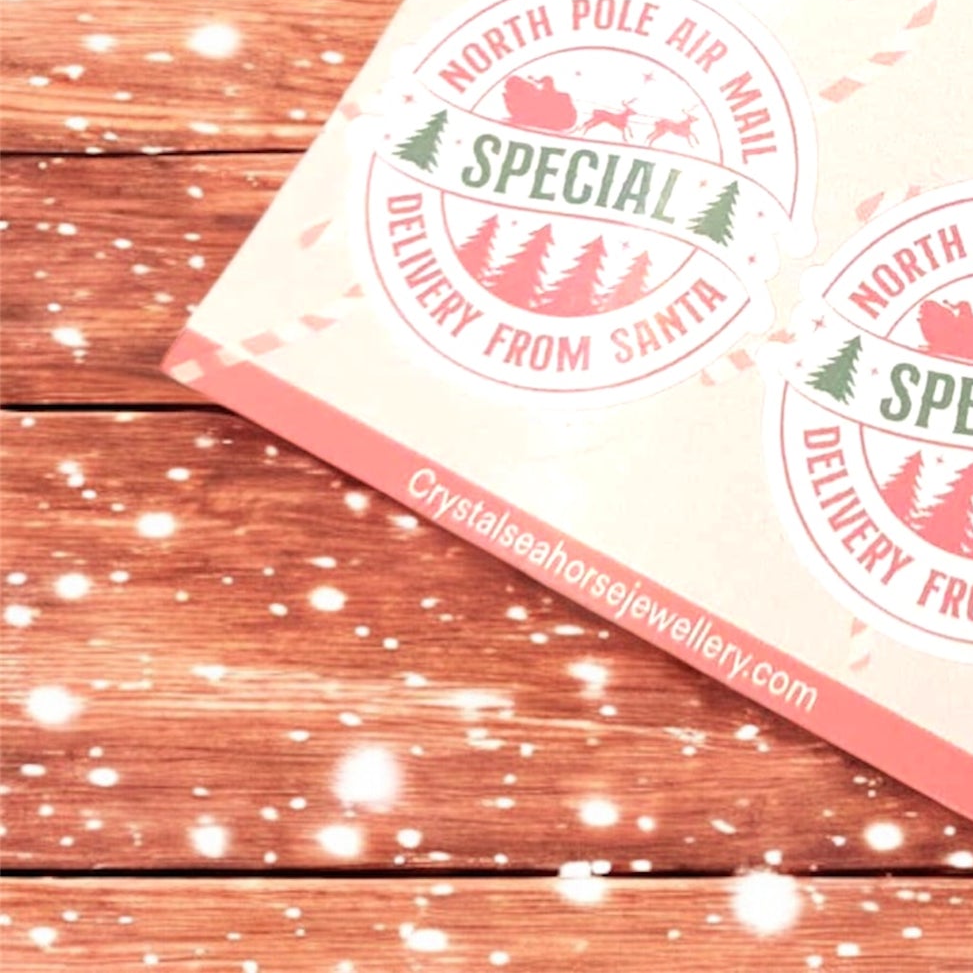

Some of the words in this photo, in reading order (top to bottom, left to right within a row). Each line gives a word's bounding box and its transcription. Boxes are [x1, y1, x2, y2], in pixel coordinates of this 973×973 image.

[438, 5, 553, 94] NORTH
[665, 18, 728, 73] AIR
[719, 71, 778, 165] MAIL
[461, 134, 682, 224] SPECIAL
[386, 193, 484, 337] DELIVERY
[483, 323, 591, 372] FROM
[610, 277, 727, 364] SANTA
[848, 224, 967, 320] NORTH
[803, 426, 915, 585] DELIVERY
[407, 467, 818, 711] Crystalseahorsejewellery.com
